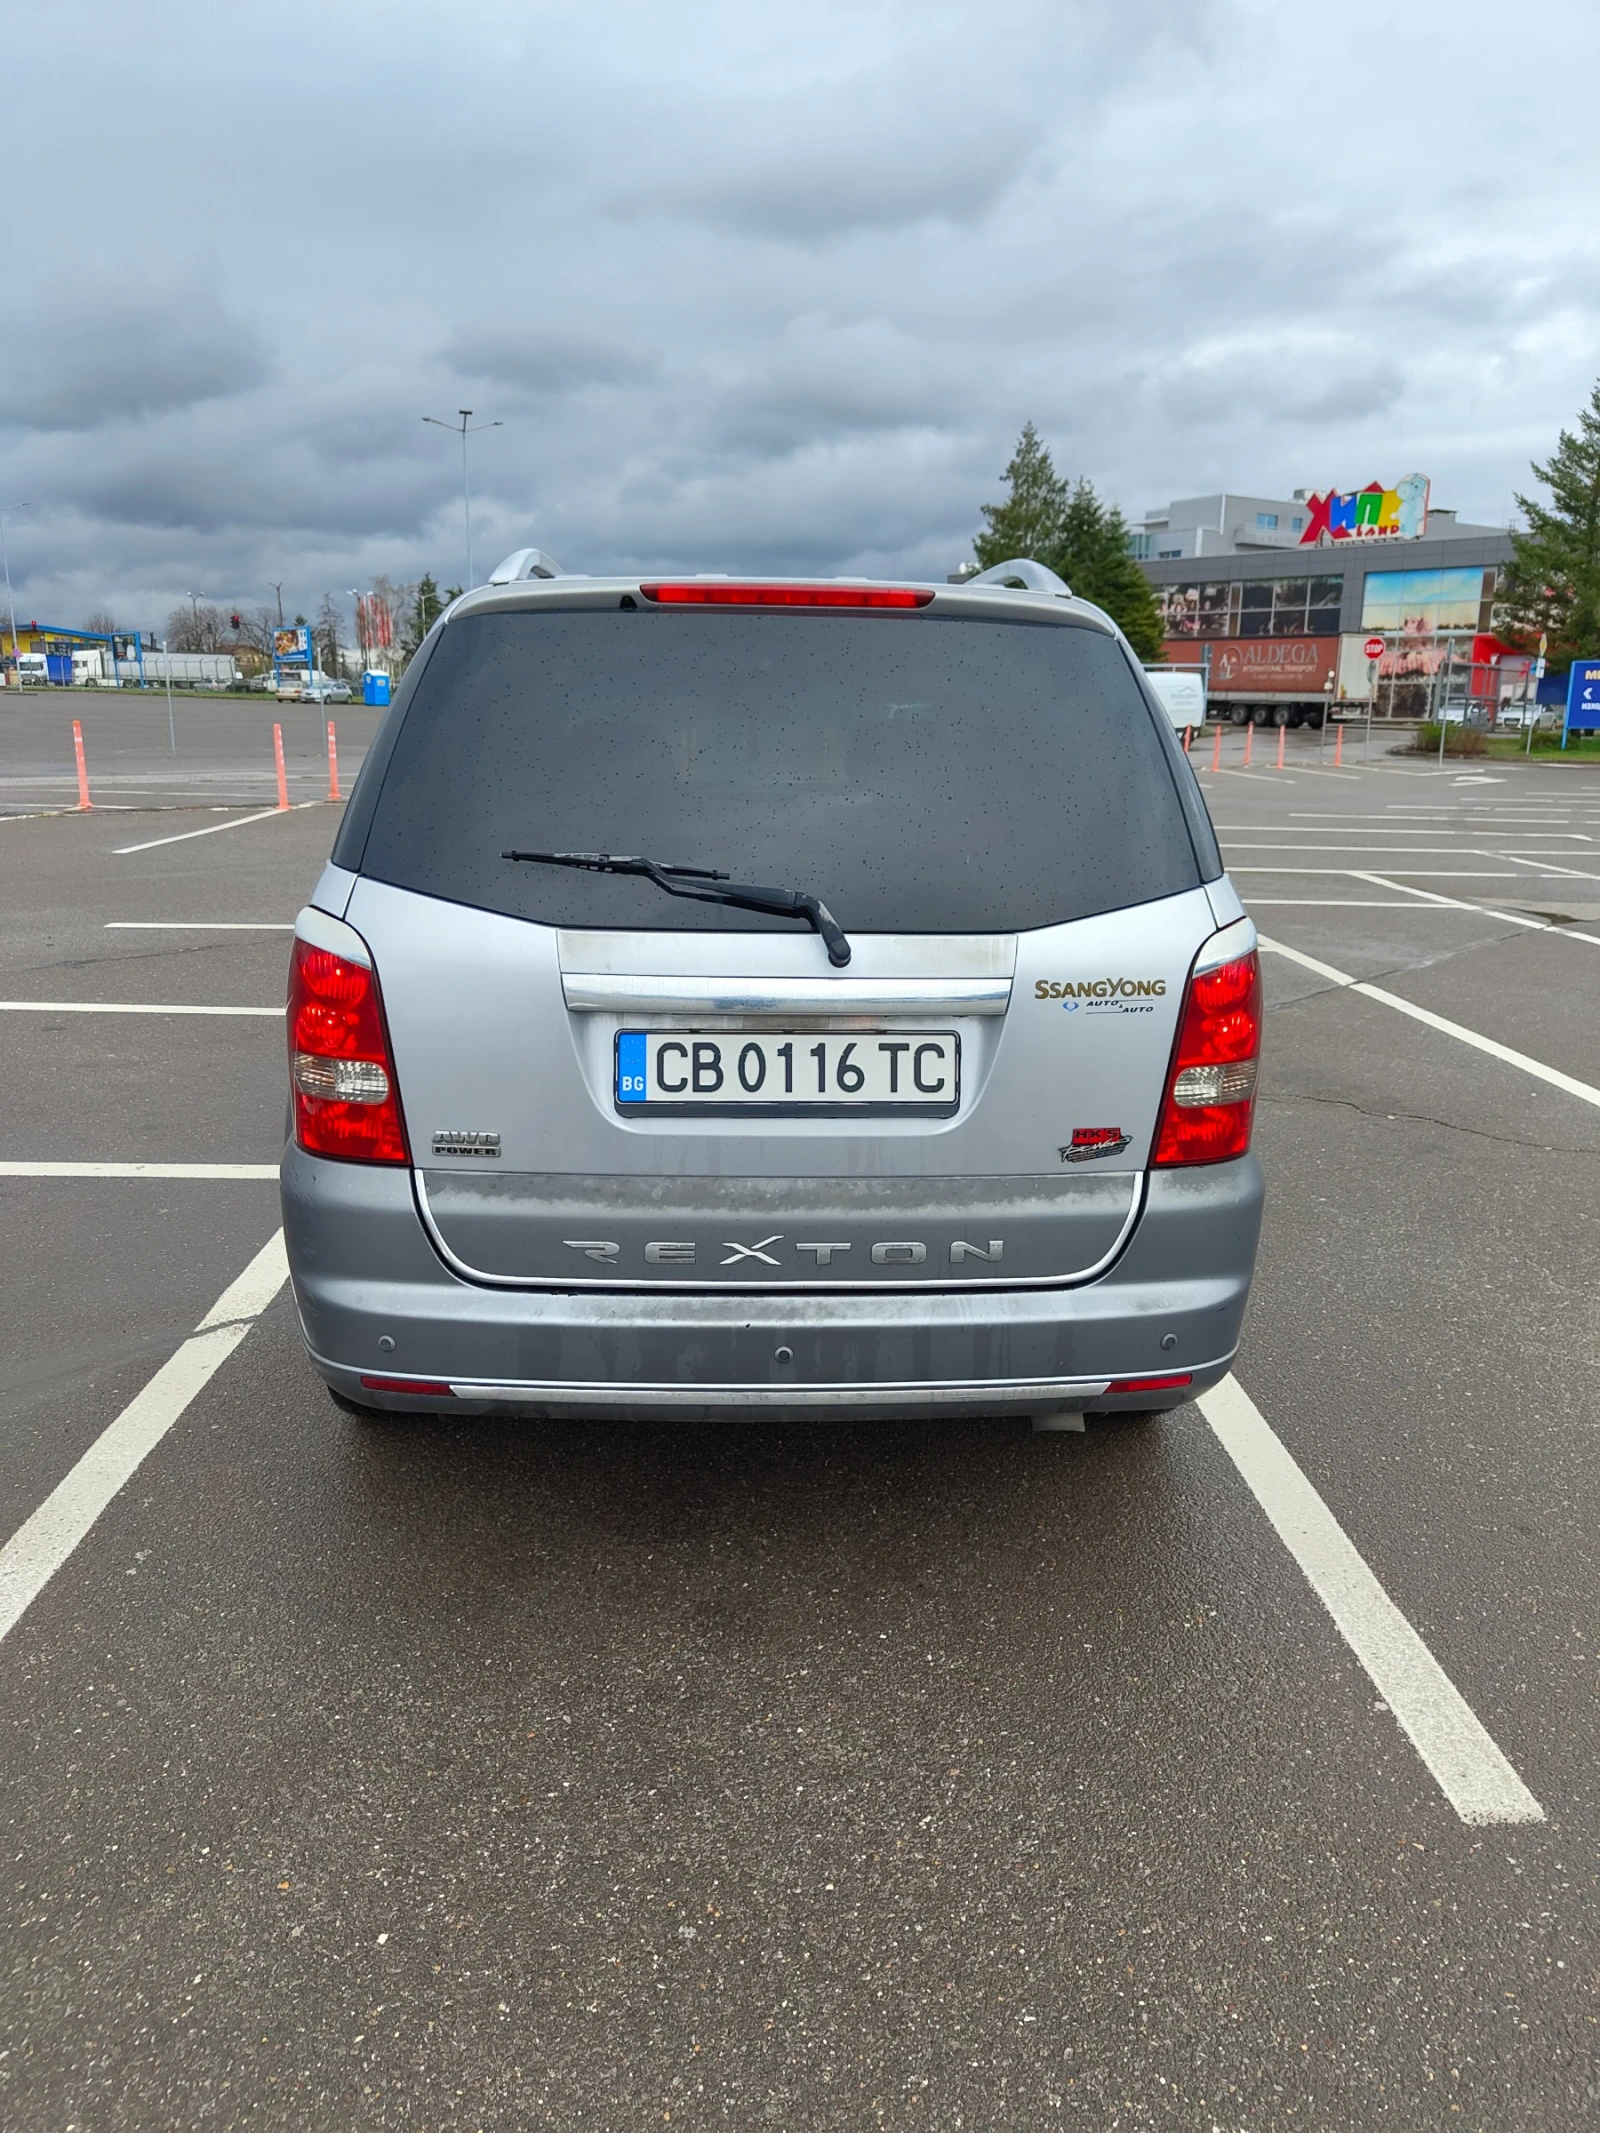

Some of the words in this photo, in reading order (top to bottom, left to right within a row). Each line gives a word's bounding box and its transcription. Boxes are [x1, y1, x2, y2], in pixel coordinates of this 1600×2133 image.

[1356, 525, 1400, 537] LAND
[1243, 643, 1320, 664] ALDEGA
[1365, 643, 1384, 654] STOP
[1283, 664, 1318, 673] TRANSPORT
[656, 1041, 724, 1093] CB
[737, 1041, 865, 1093] 0116
[878, 1042, 945, 1093] TC
[622, 1076, 644, 1091] BG
[432, 1130, 500, 1145] AWD
[1075, 1129, 1119, 1139] HKS
[435, 1147, 497, 1155] POWER
[562, 1235, 1004, 1266] REXTON
